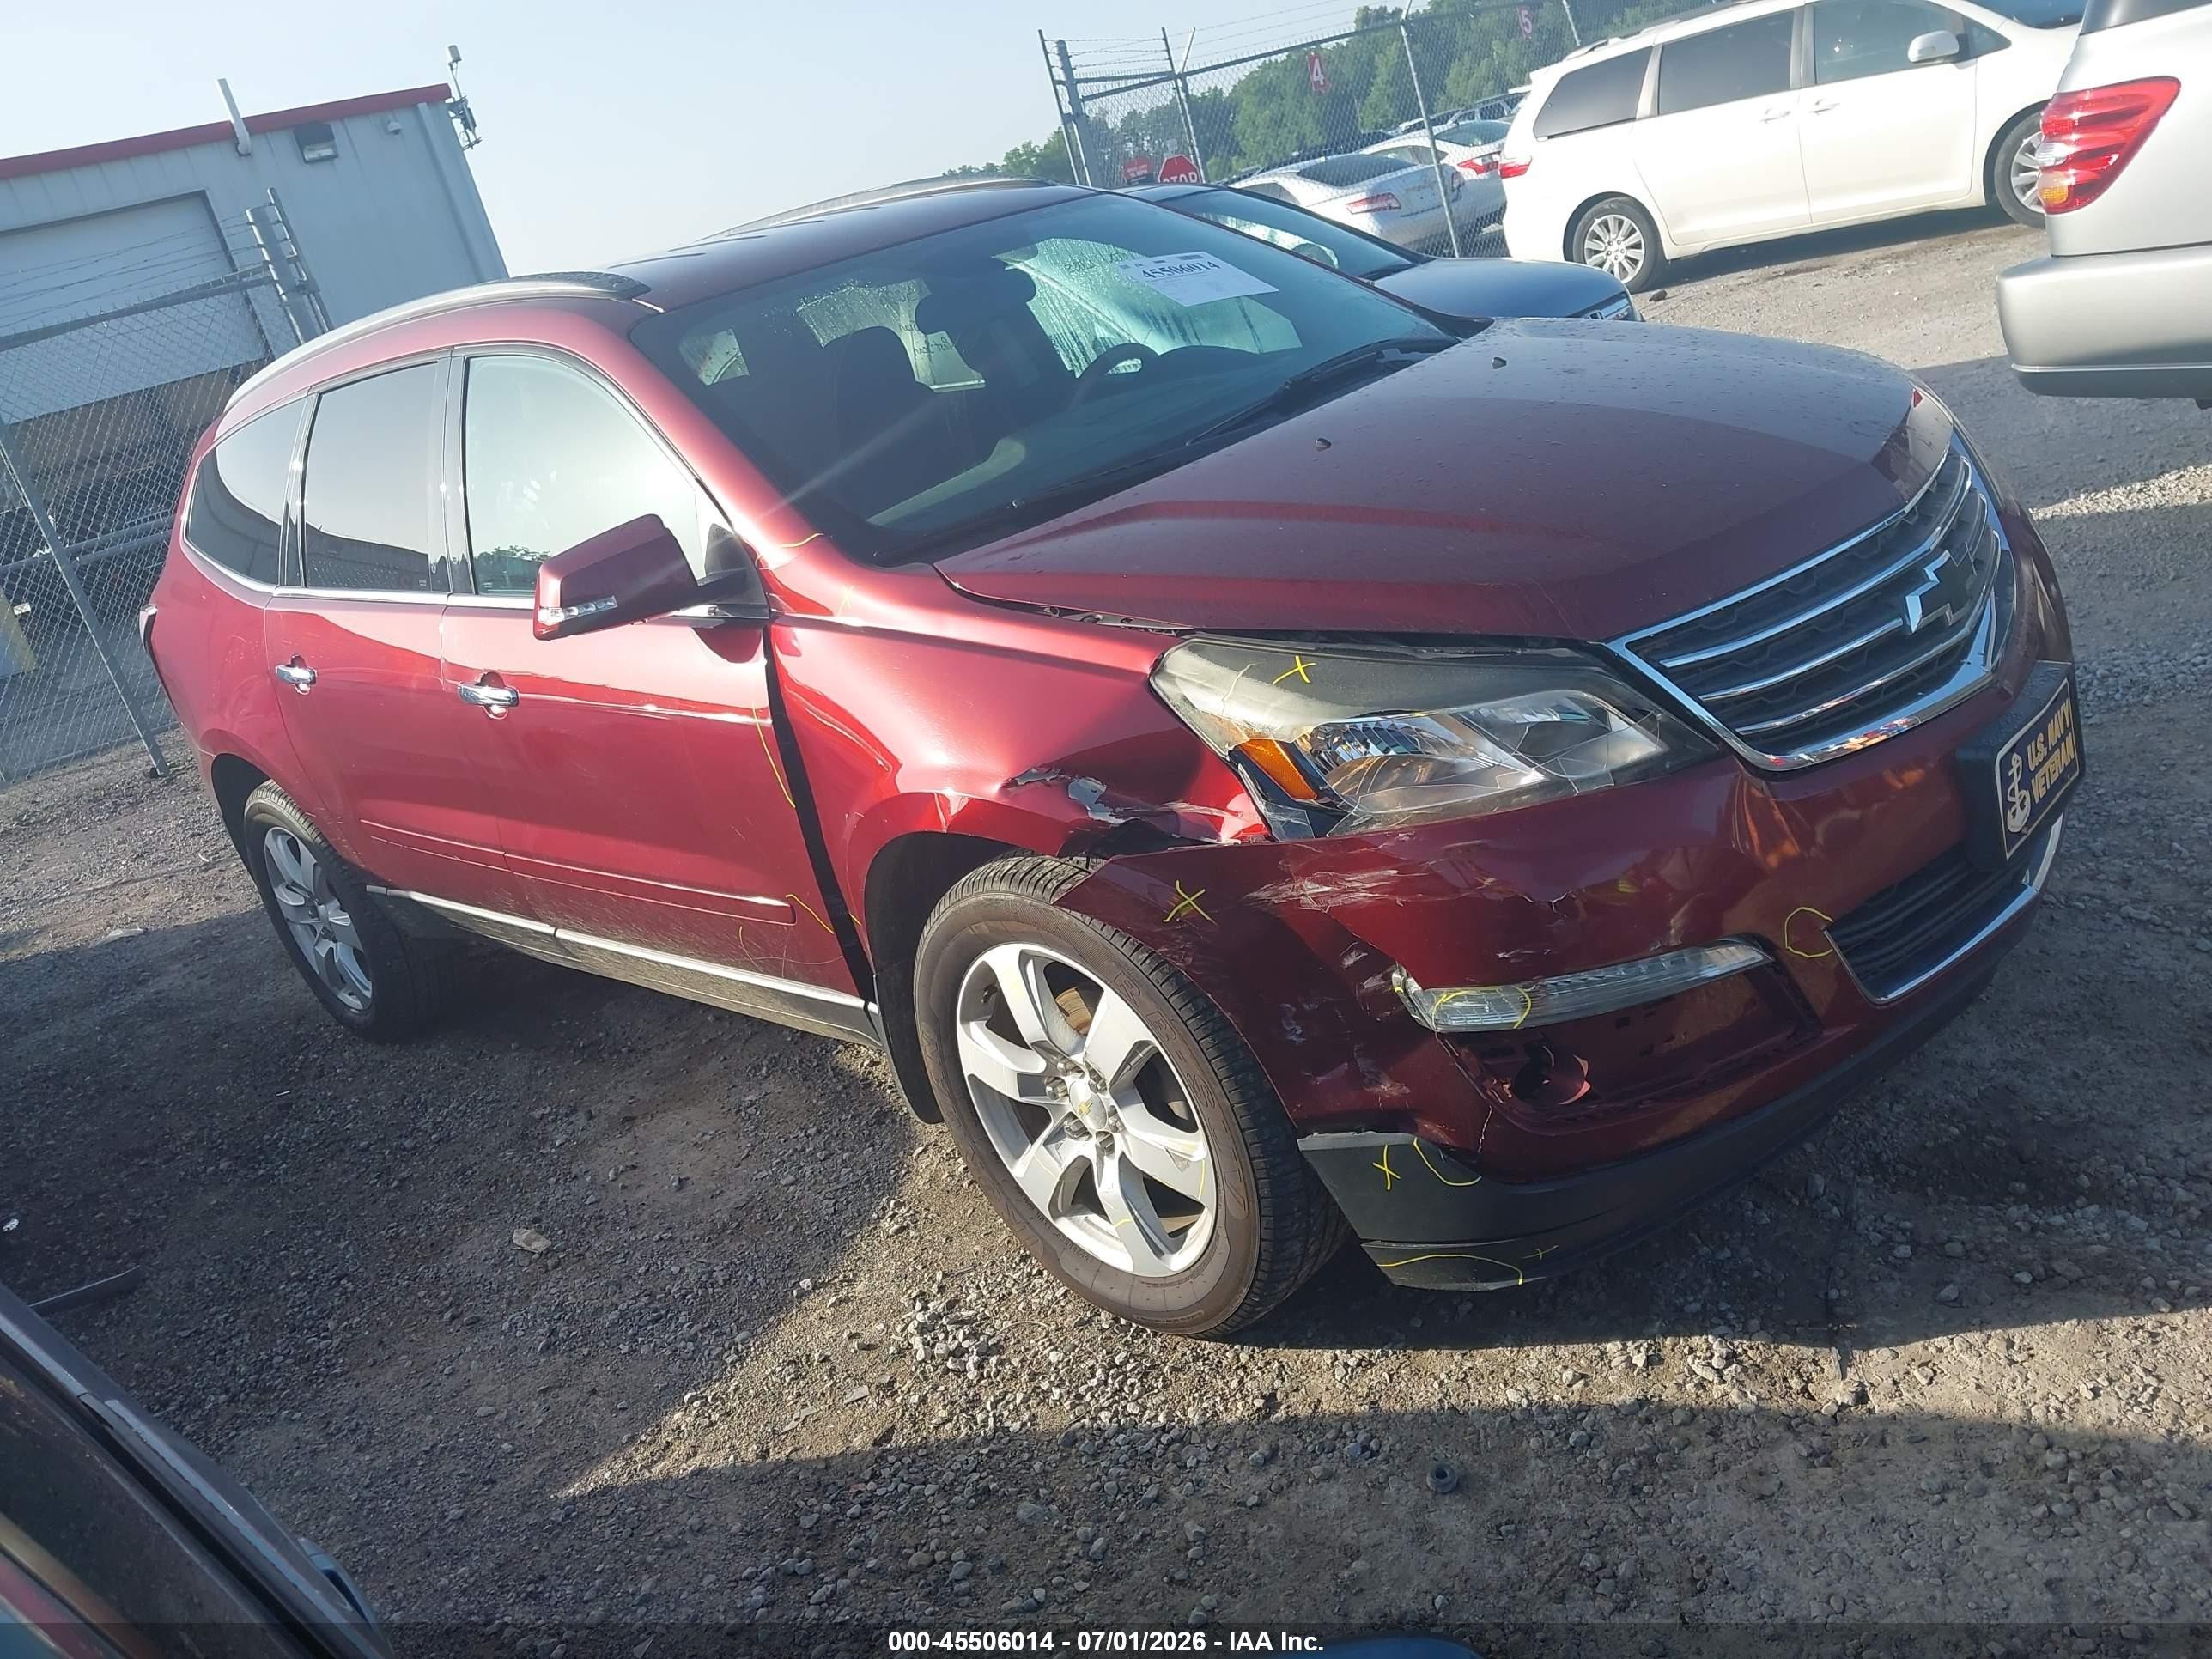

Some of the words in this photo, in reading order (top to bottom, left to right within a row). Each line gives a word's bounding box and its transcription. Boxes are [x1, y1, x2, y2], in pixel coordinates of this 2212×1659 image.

[1521, 9, 1532, 33] 5
[1313, 58, 1324, 85] 4
[1142, 260, 1221, 279] 45506014
[2027, 732, 2048, 771] U.S.
[2047, 698, 2072, 751] NAVY
[2031, 732, 2075, 804] VETERAN
